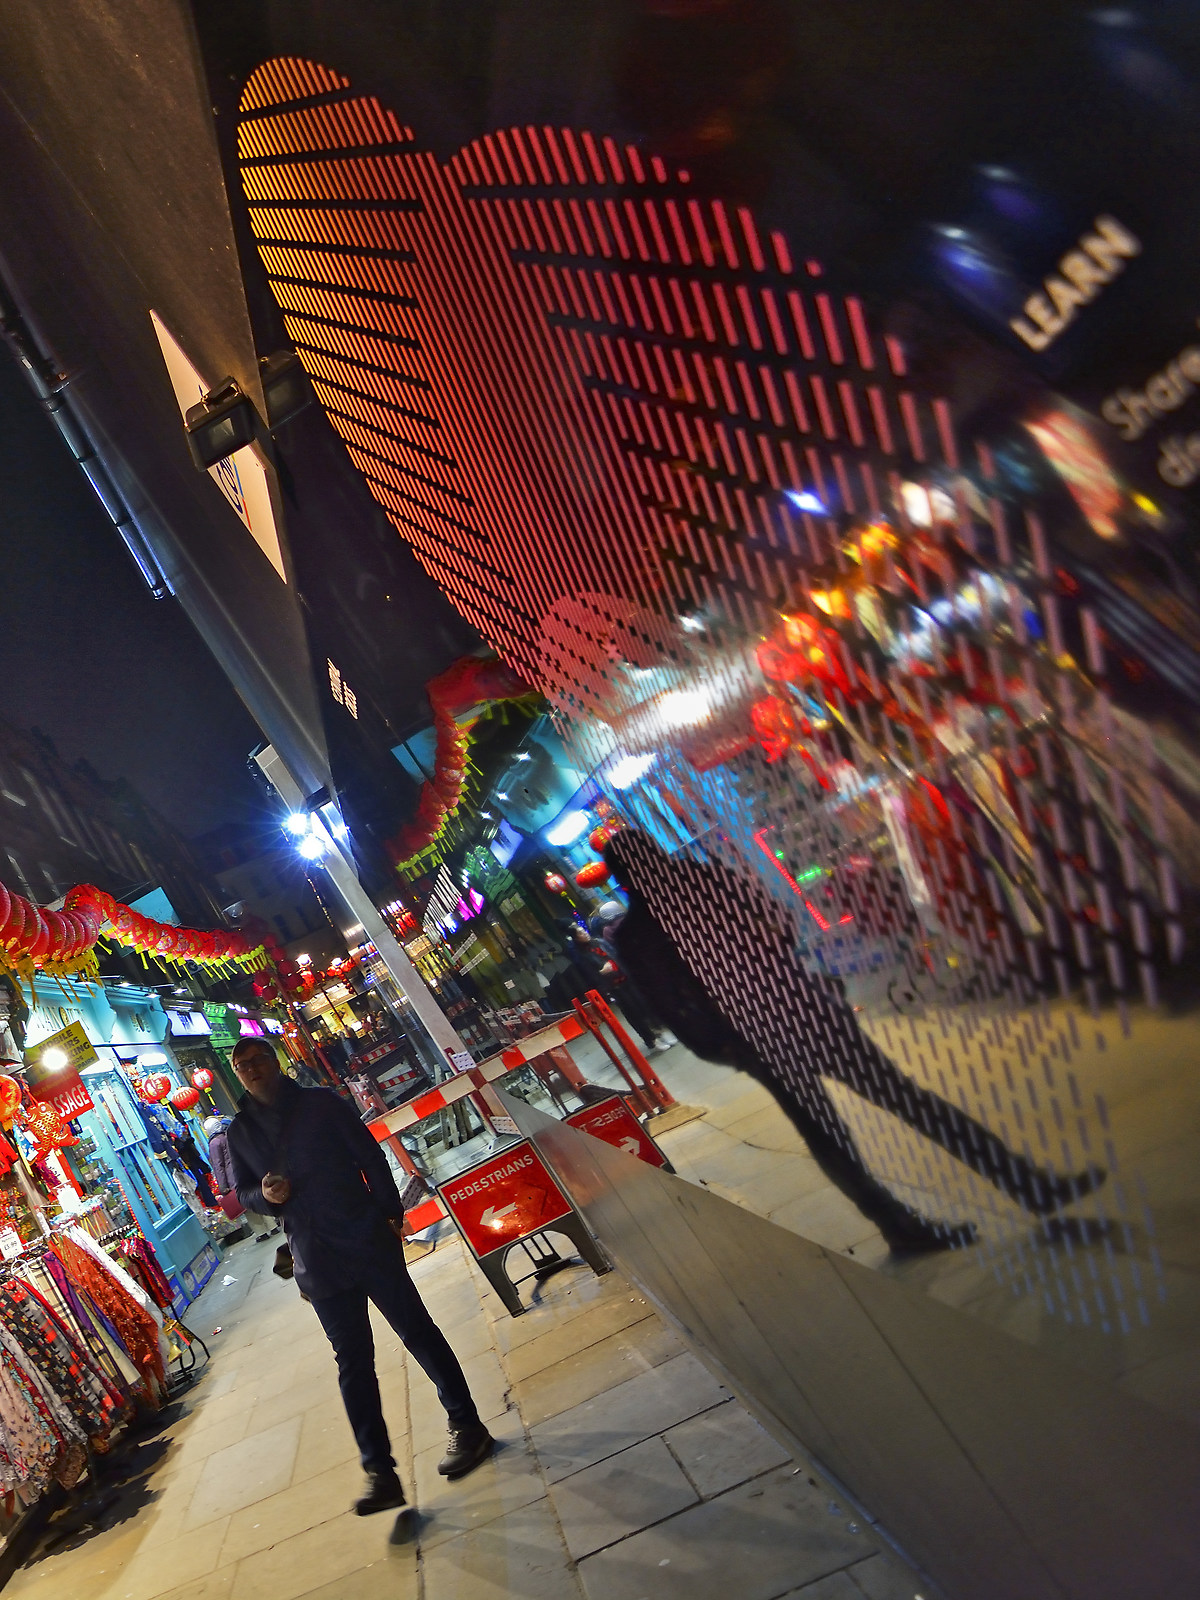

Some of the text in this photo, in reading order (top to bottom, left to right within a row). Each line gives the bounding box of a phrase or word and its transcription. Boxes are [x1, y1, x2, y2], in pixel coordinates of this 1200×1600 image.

[1009, 214, 1142, 351] LEARN
[50, 1083, 91, 1119] SSAGE
[449, 1153, 534, 1205] PEDESTRIANS
